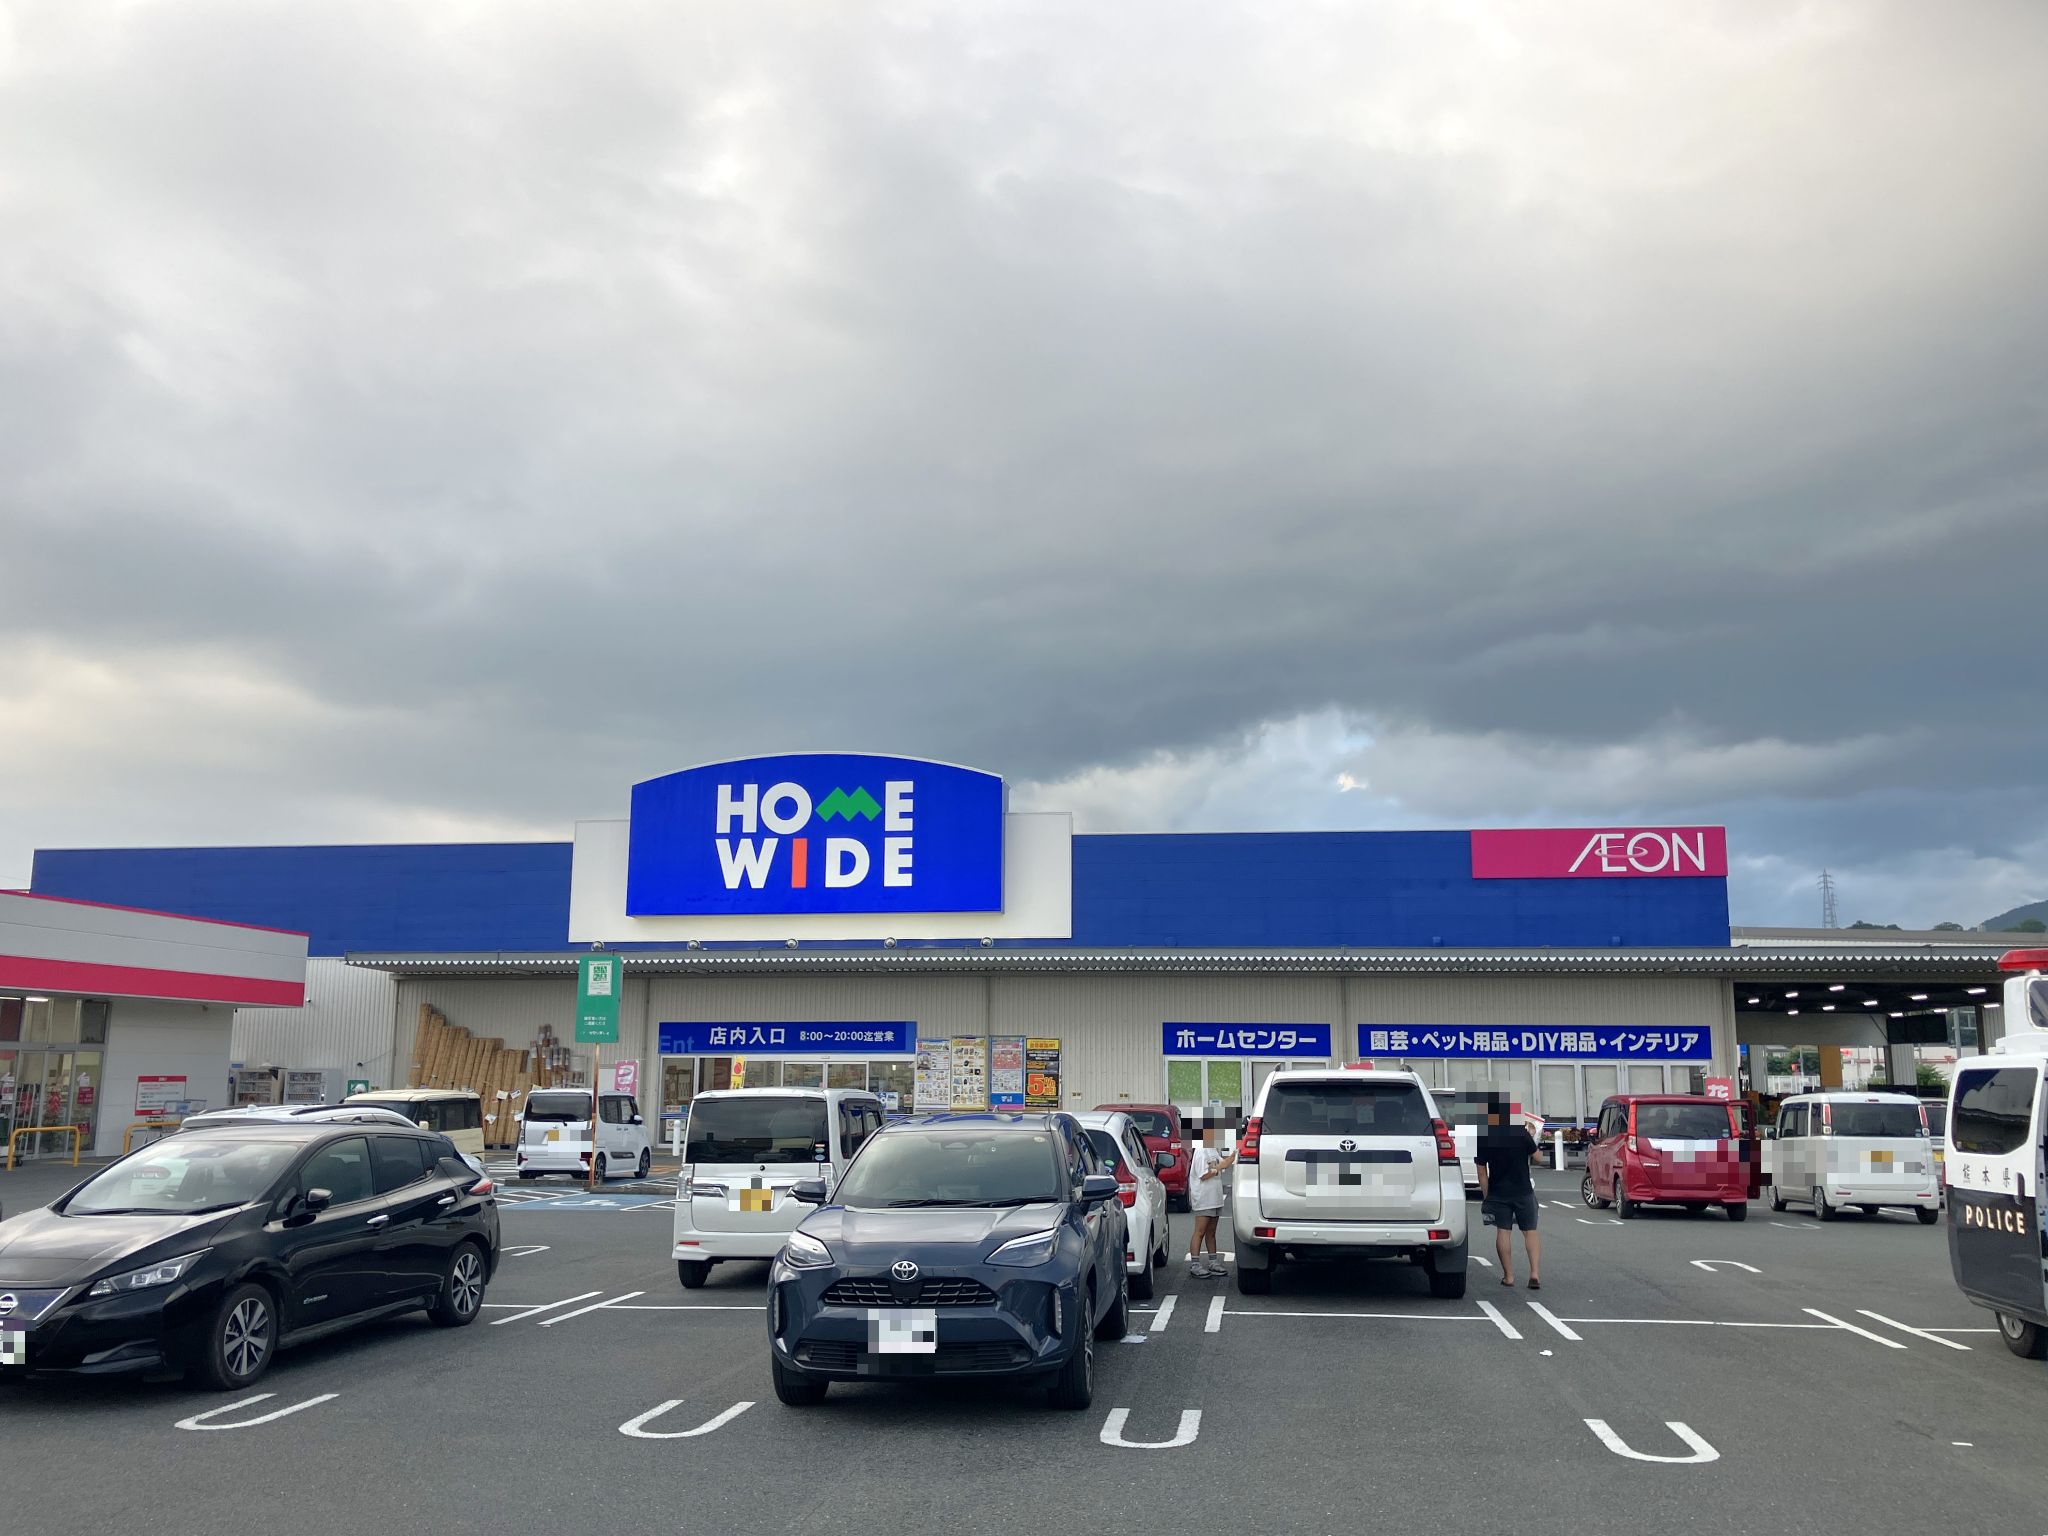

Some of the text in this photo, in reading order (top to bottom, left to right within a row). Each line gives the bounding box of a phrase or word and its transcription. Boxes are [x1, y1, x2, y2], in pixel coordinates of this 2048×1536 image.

[716, 780, 914, 835] HOME
[715, 836, 913, 889] WIDE
[709, 1027, 785, 1045] 店内入口
[1176, 1029, 1317, 1049] ホームセンター
[1965, 1204, 2026, 1235] POLICE
